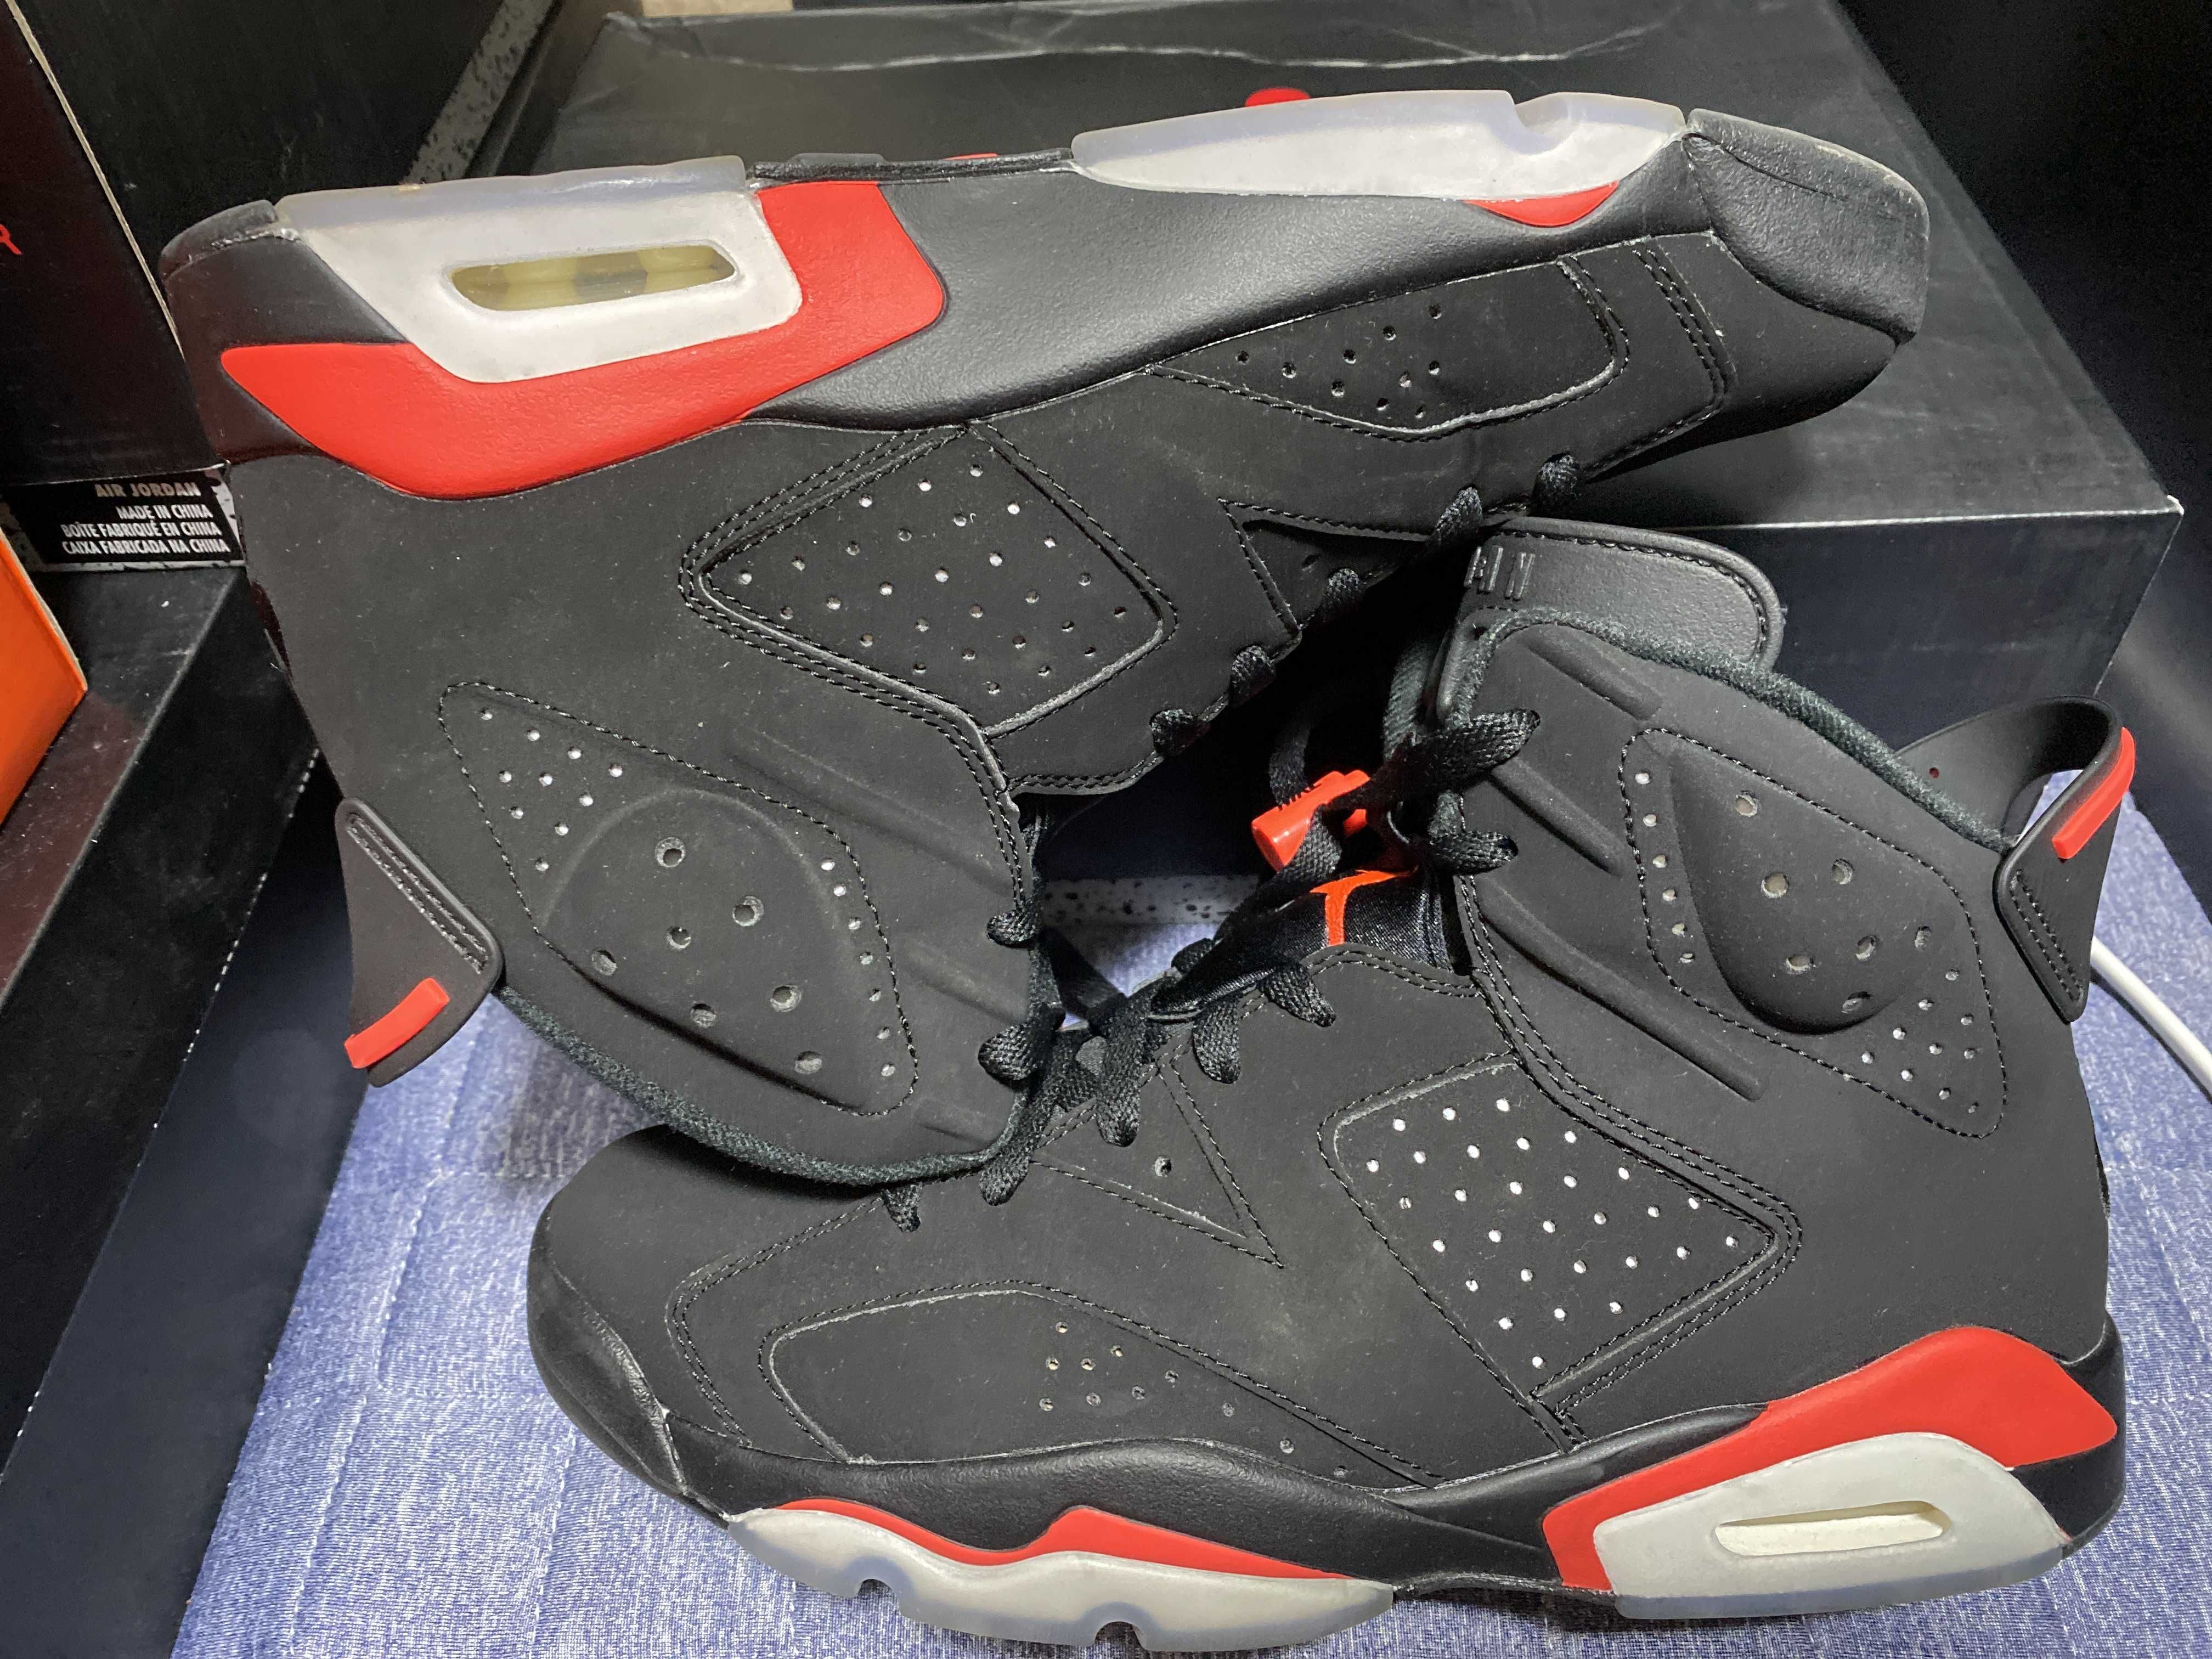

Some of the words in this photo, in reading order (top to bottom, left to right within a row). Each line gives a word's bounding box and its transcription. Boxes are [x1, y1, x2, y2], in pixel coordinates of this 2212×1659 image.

[95, 483, 127, 497] AIR
[130, 482, 201, 496] JORDAN
[115, 505, 155, 520] MADE
[153, 505, 172, 519] IN
[171, 504, 213, 519] CHINA
[60, 521, 100, 537] BOÎTE
[97, 520, 162, 537] FABRIQUÉ
[160, 522, 180, 537] EN
[179, 521, 223, 537] CHINA
[61, 540, 102, 554] CAIXA
[99, 539, 171, 554] FABRICADA
[167, 539, 190, 553] NA
[189, 539, 231, 553] CHINA
